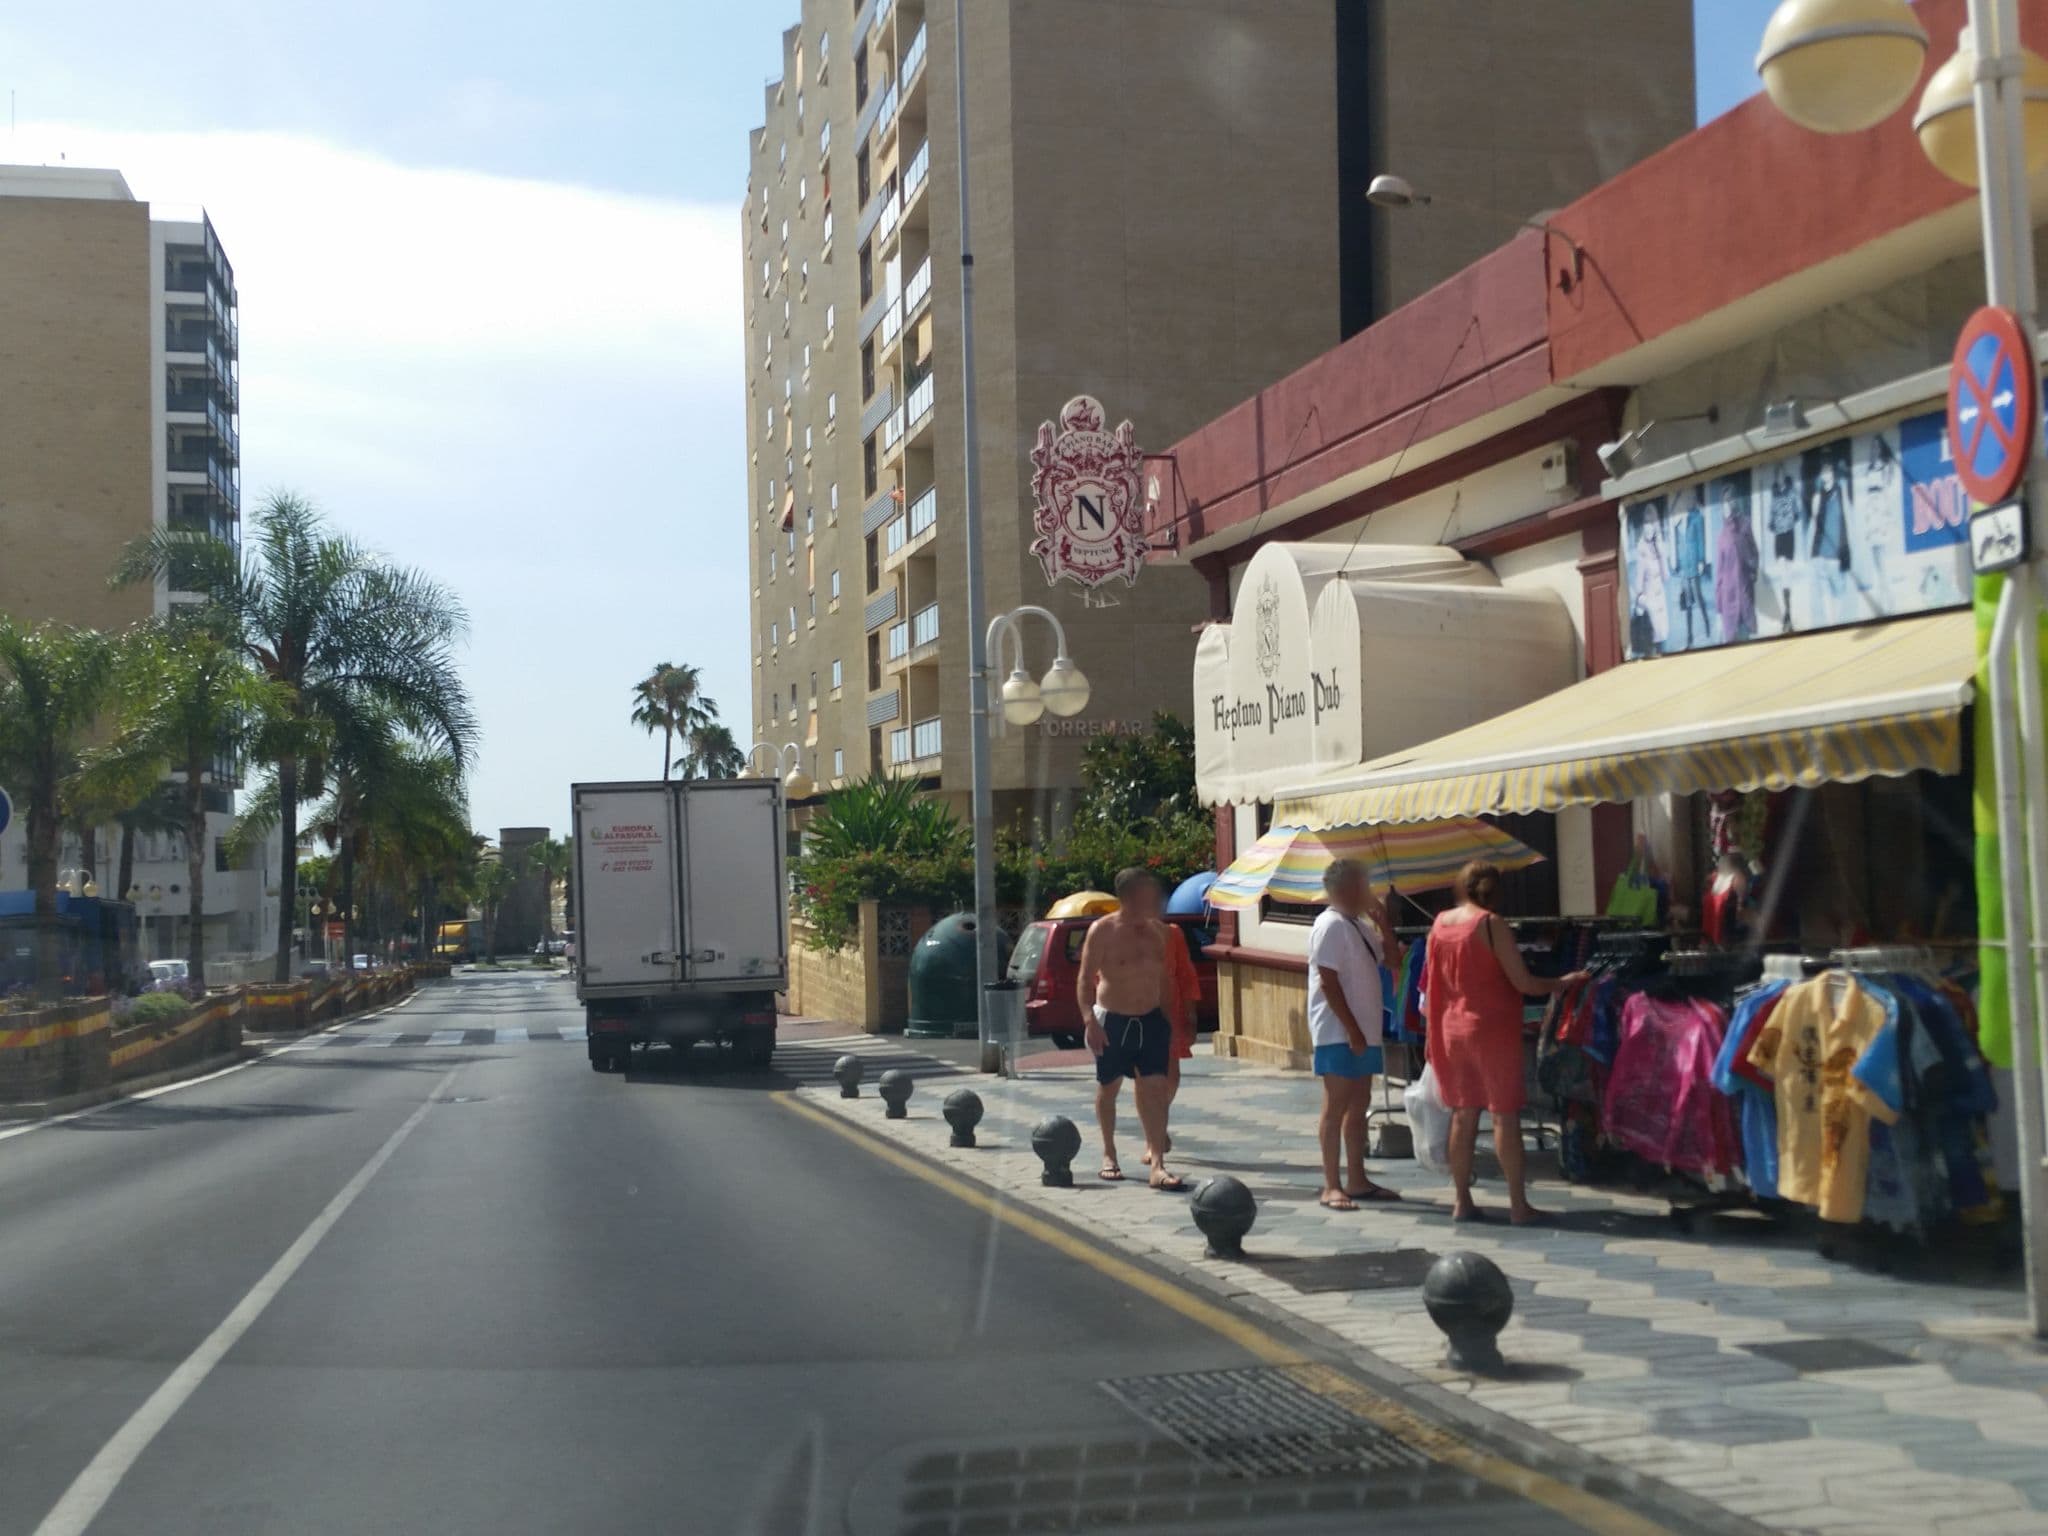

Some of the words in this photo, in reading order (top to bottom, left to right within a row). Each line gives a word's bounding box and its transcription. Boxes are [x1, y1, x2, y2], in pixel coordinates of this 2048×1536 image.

[1065, 436, 1093, 450] PIANO
[1096, 436, 1115, 450] BAR
[1074, 494, 1106, 531] N
[1072, 545, 1113, 558] NEPTUNO
[1212, 694, 1262, 742] Neptuno
[1266, 682, 1306, 735] Piano
[1310, 667, 1341, 727] Pub
[1037, 719, 1143, 738] TORREMAR
